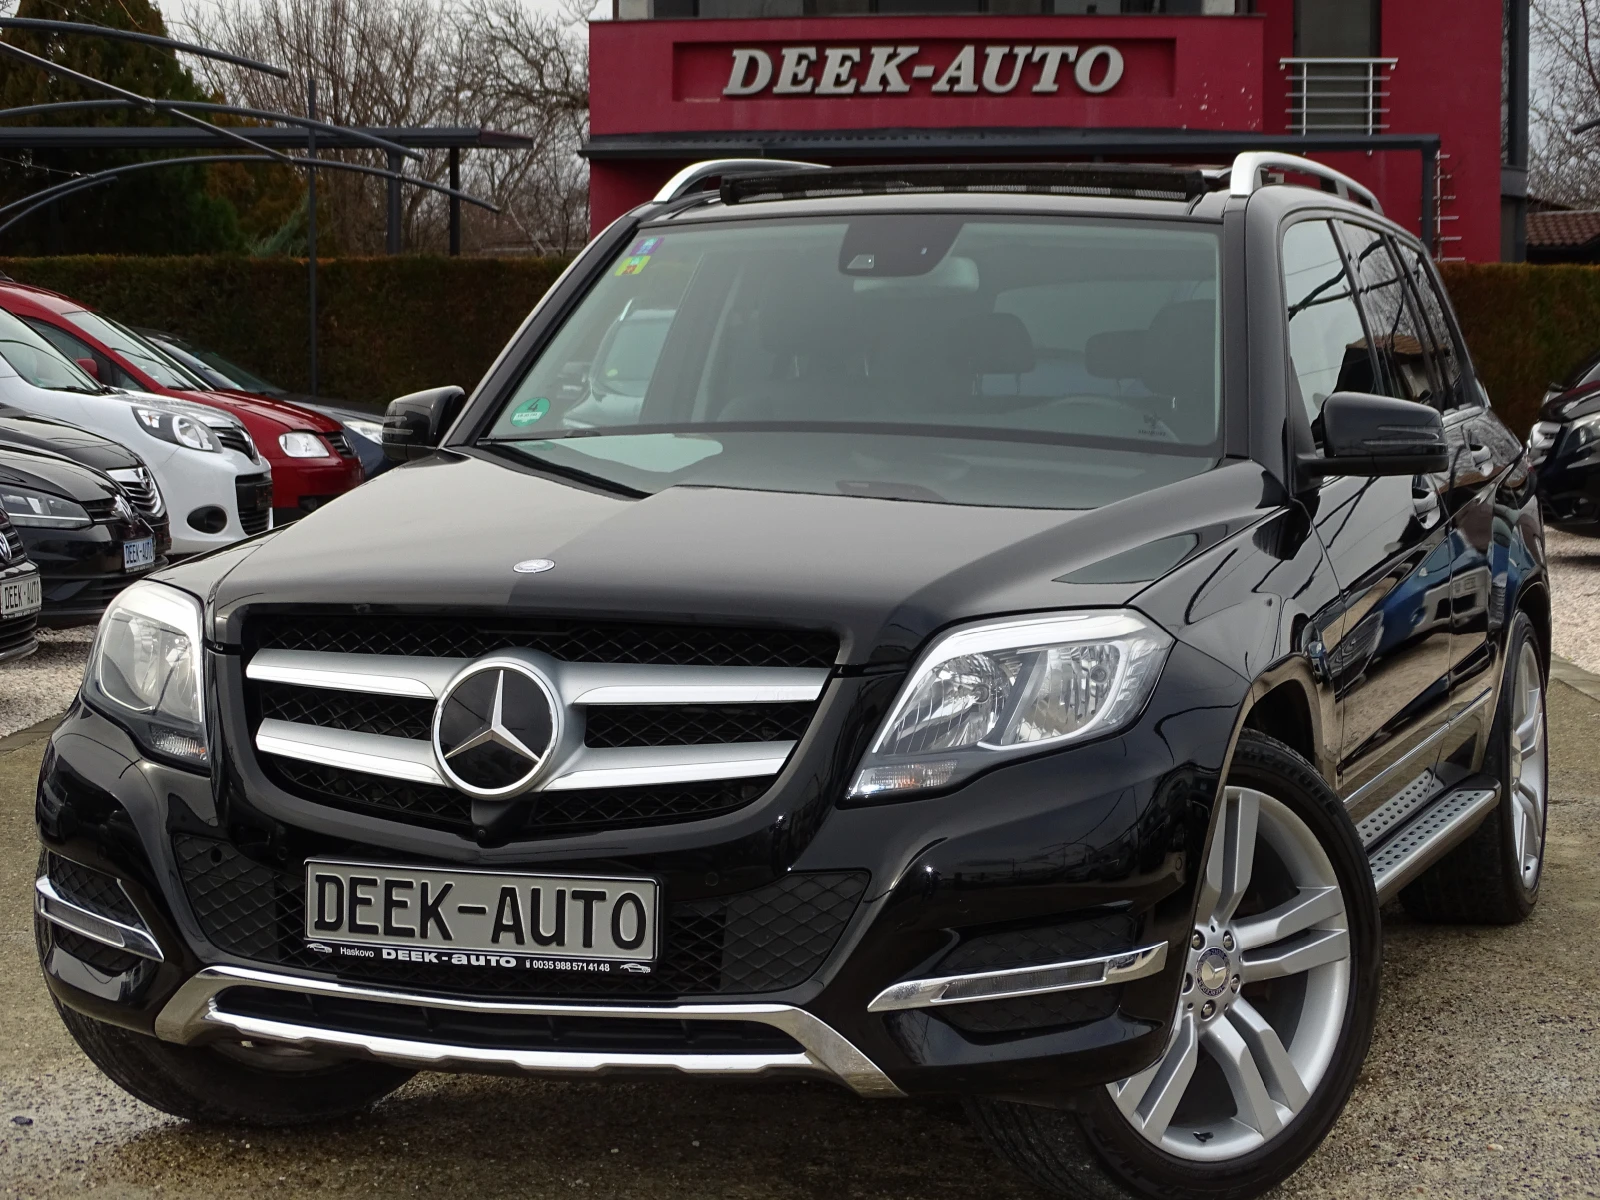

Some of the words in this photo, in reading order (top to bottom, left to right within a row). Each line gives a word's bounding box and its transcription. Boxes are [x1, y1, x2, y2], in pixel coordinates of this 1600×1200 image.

[722, 45, 1125, 95] DEEK-AUTO
[526, 398, 541, 412] 4
[314, 874, 647, 950] DEEK-AUTO
[340, 945, 375, 958] Haskovo
[532, 960, 554, 969] 0035
[555, 961, 571, 970] 988
